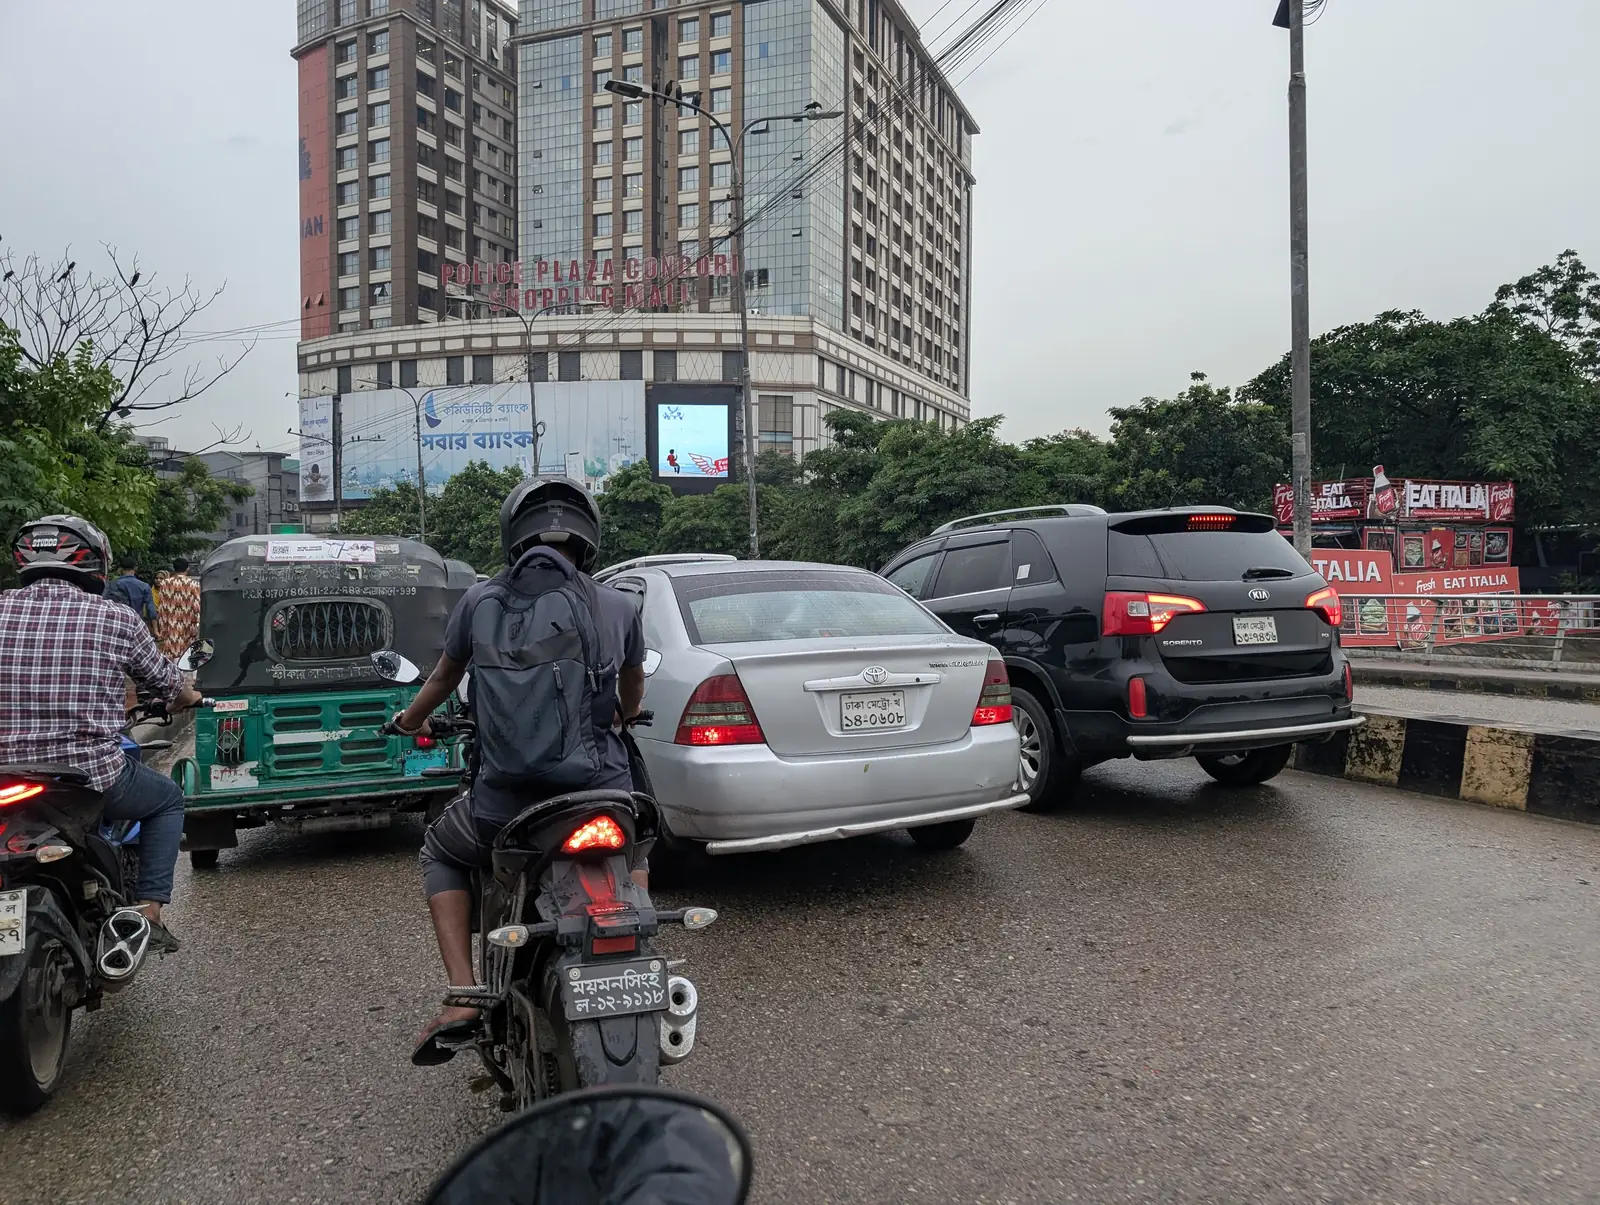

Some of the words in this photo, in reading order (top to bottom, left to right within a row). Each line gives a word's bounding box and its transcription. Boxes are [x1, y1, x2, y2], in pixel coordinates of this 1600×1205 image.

[441, 261, 524, 286] POLICE
[537, 258, 616, 282] PLAZA
[488, 285, 614, 312] SHOPPING
[443, 401, 492, 416] কমিউনিটি
[497, 403, 529, 414] ব্যাংক
[420, 432, 469, 450] সবার
[472, 431, 534, 450] ব্যাংক
[1274, 486, 1294, 505] Fre
[1322, 483, 1345, 496] EAT
[1409, 485, 1439, 508] EAT
[1440, 484, 1485, 509] ITALIA
[1490, 483, 1514, 503] Fresh
[1316, 496, 1352, 510] ITALIA
[1494, 503, 1512, 520] Cola
[1312, 559, 1382, 582] TALIA
[1416, 577, 1436, 594] Fresh
[1443, 576, 1467, 589] EAT
[1469, 574, 1508, 588] ITALIA
[1250, 590, 1269, 600] KIA
[1236, 622, 1249, 630] ঢাকা
[845, 700, 864, 710] ঢাকা
[844, 712, 904, 727] ১৪-০৬০৮
[569, 969, 661, 995] ময়মনসিংহ
[575, 989, 664, 1013] ল-১২-৯১১৮
